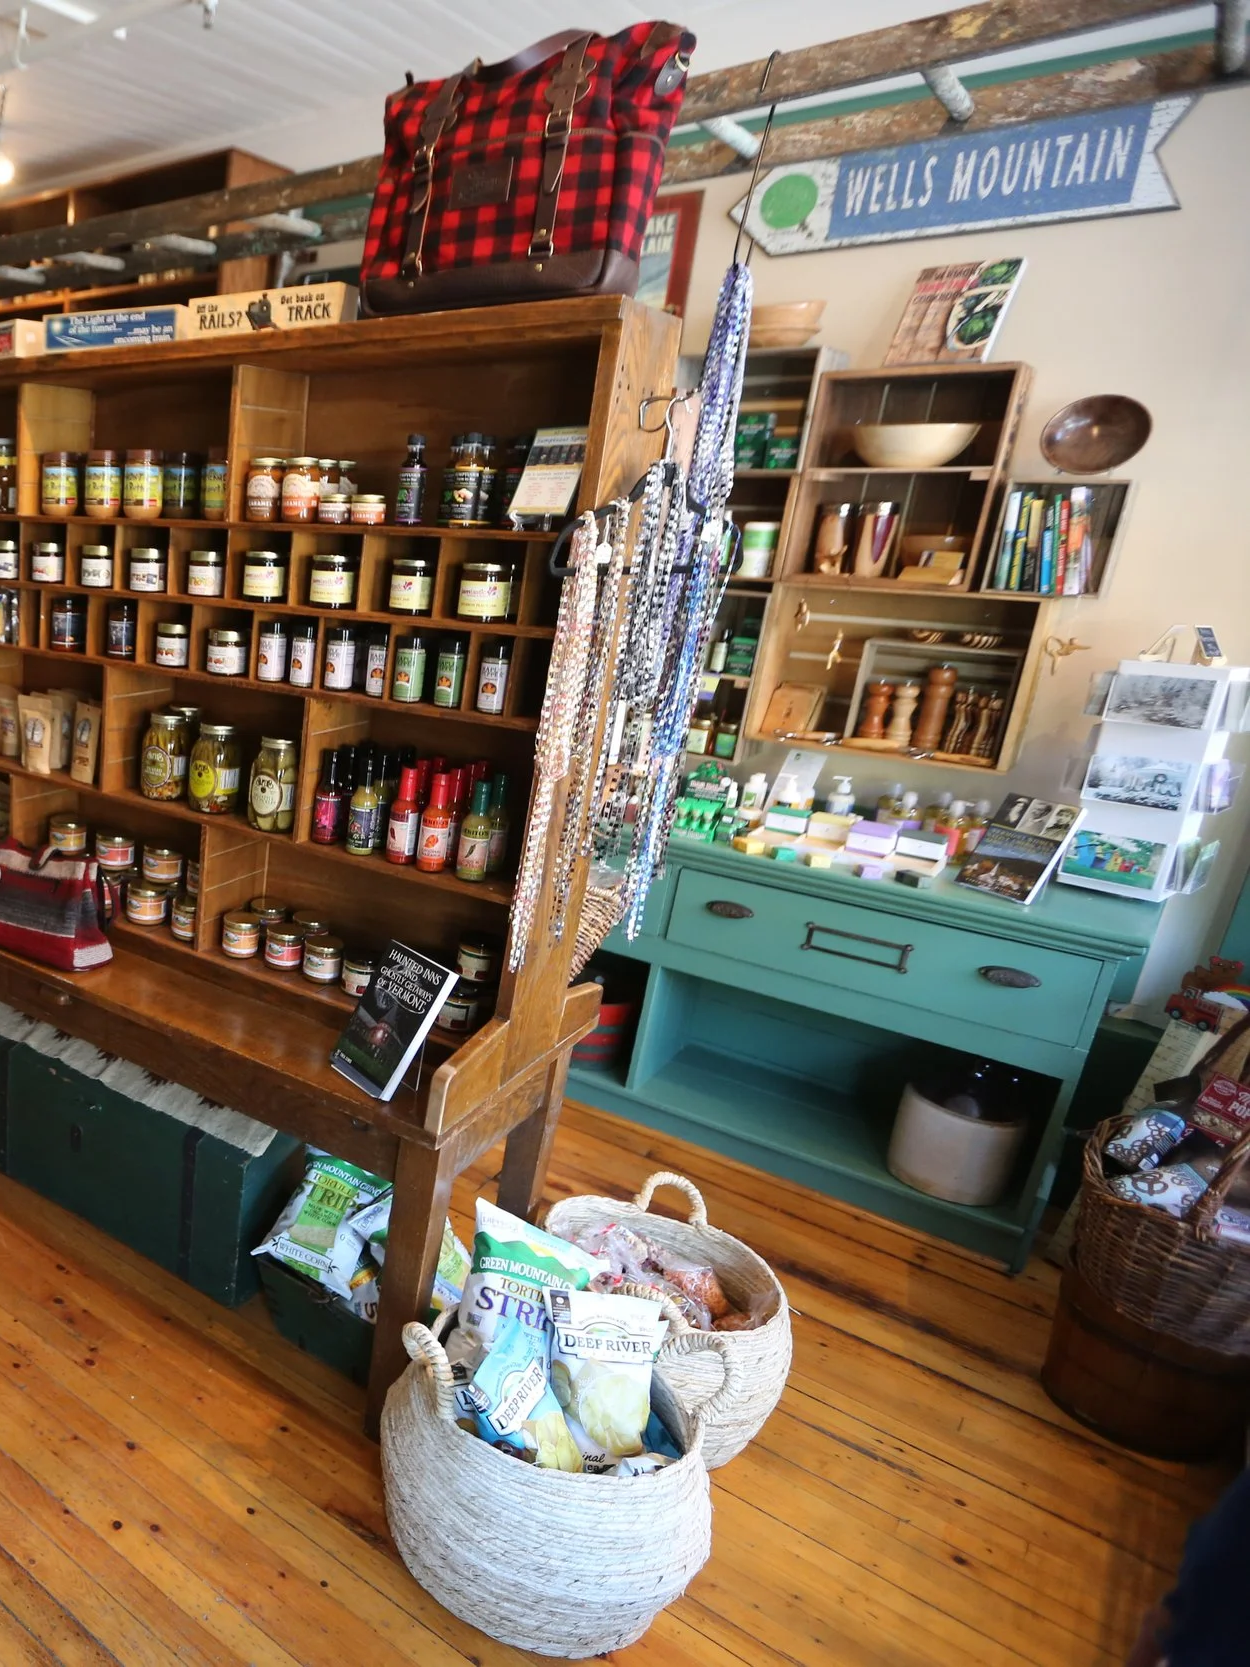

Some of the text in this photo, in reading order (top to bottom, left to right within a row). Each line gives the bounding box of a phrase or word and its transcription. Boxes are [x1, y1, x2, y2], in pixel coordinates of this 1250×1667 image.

[845, 125, 1135, 217] WELLS MOUNTAIN
[69, 311, 145, 326] The Light at the end
[69, 324, 77, 334] of
[78, 324, 90, 334] the
[163, 325, 174, 334] an
[199, 302, 331, 331] RAILS? TRACK
[114, 335, 151, 345] oncoming
[388, 948, 442, 986] HAUNTED INNS
[403, 969, 418, 982] AND
[376, 977, 428, 1012] OF VERMONT
[380, 965, 434, 1003] GHOSTLY GETAWAYS
[321, 1162, 361, 1187] MOUNTAIN
[279, 1241, 329, 1271] WHITE CORN
[479, 1256, 509, 1272] GREEN
[509, 1259, 564, 1290] MOUNTAIN
[476, 1285, 549, 1331] STRI
[564, 1333, 650, 1354] DEEP RIVER
[495, 1365, 543, 1431] DEEP RIVER
